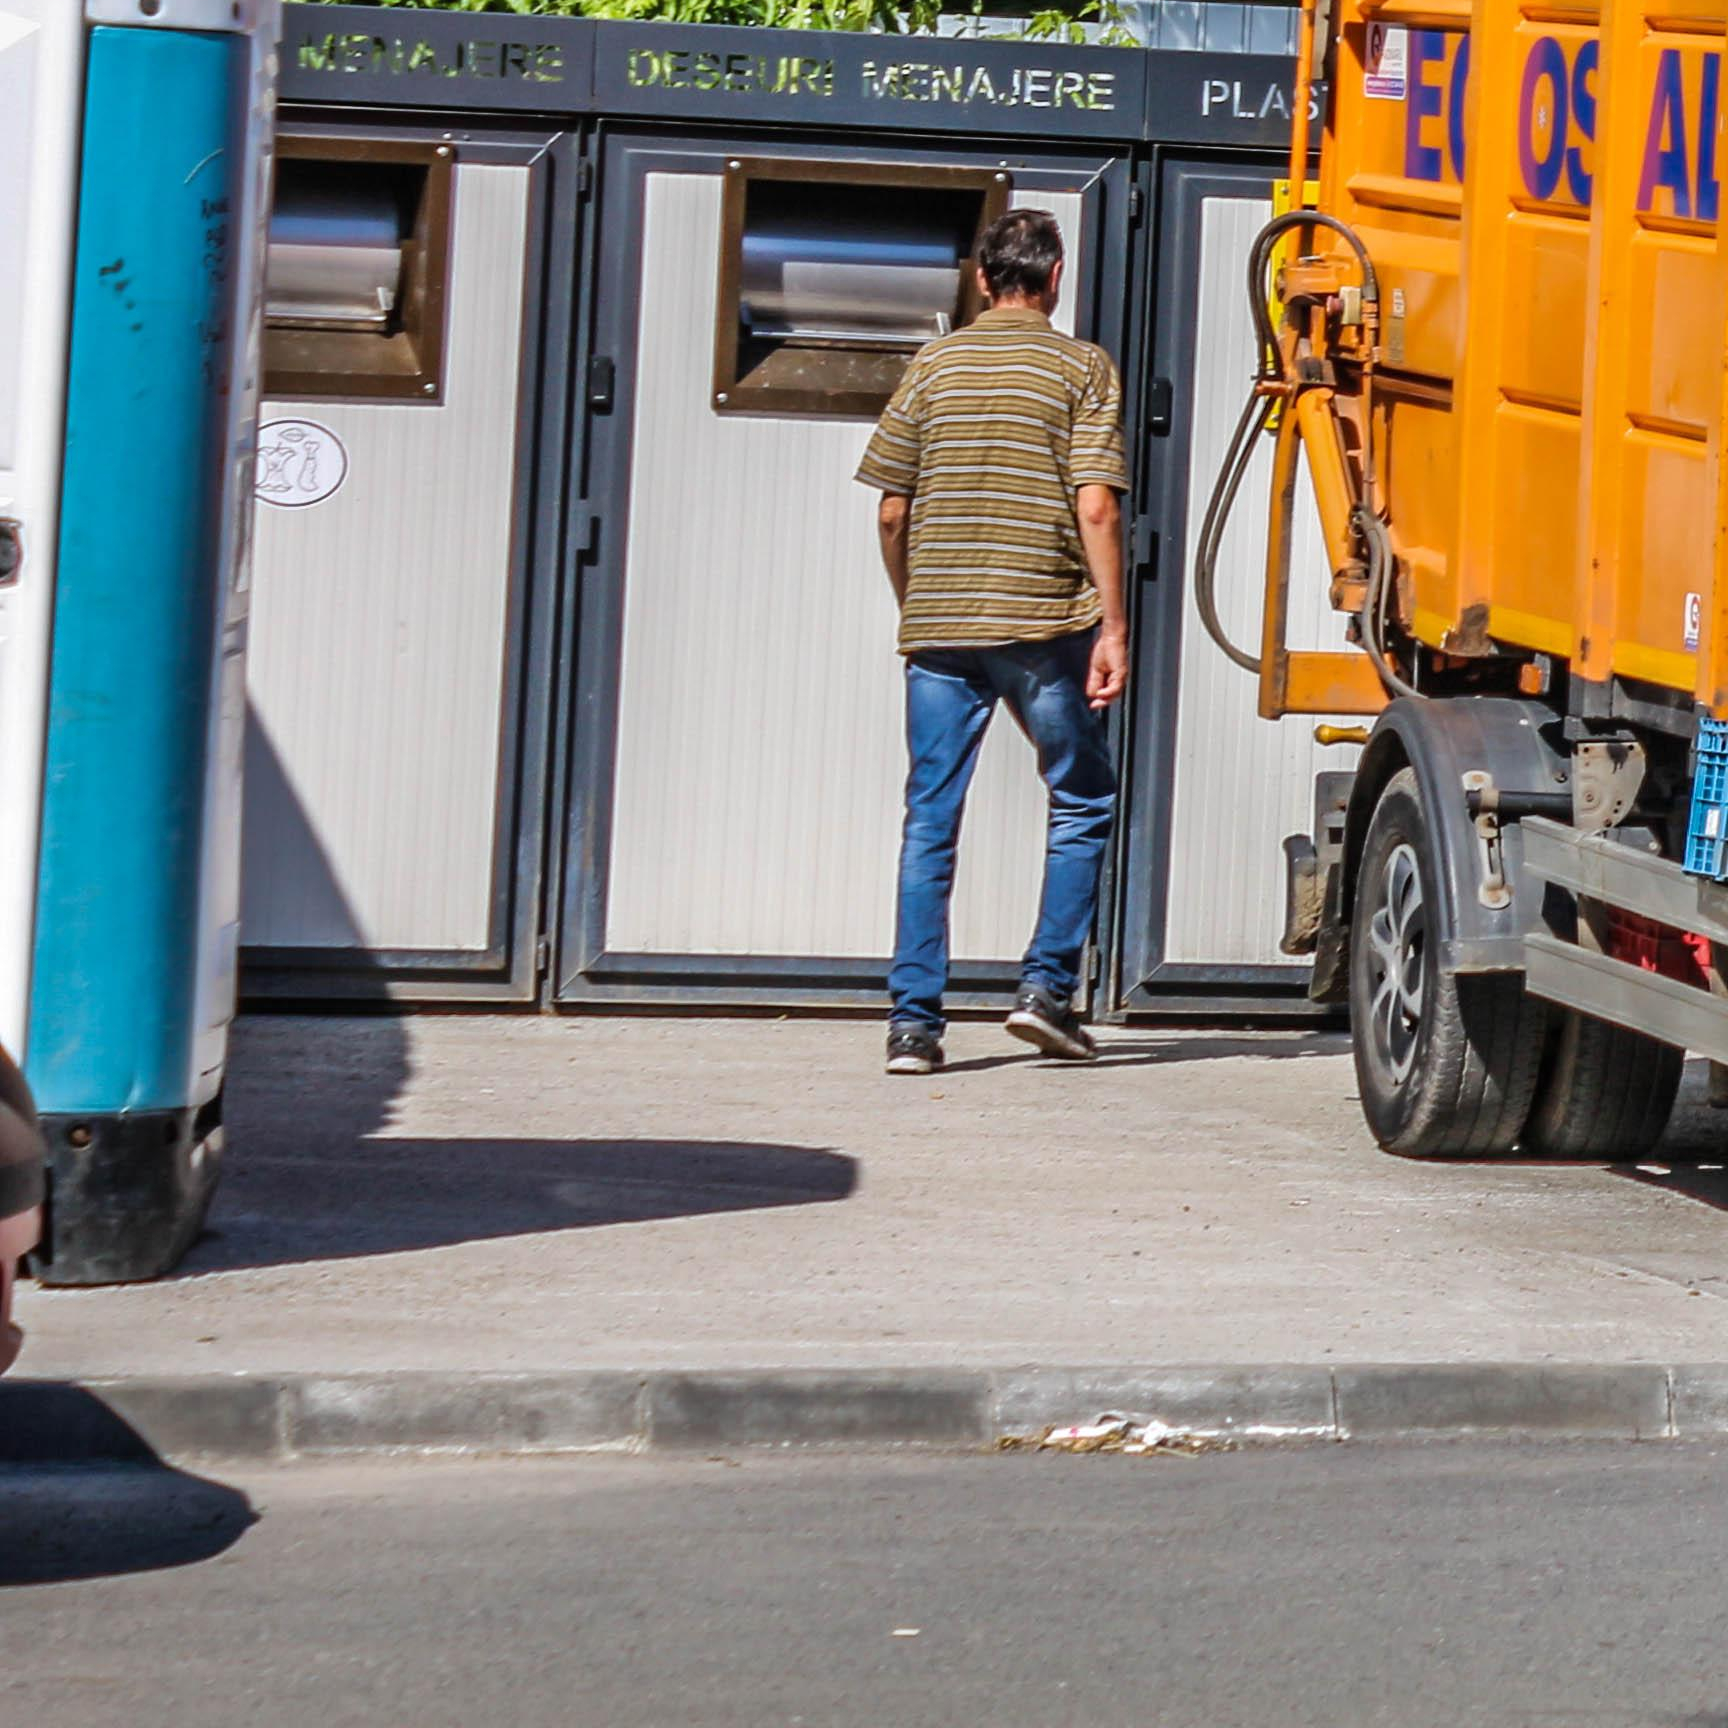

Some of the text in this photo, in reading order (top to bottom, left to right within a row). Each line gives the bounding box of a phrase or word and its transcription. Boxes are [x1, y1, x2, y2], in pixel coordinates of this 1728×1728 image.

[298, 33, 564, 82] MENAJERE
[627, 48, 1116, 111] DESEURI MENAJERE
[1201, 79, 1329, 120] PLAS
